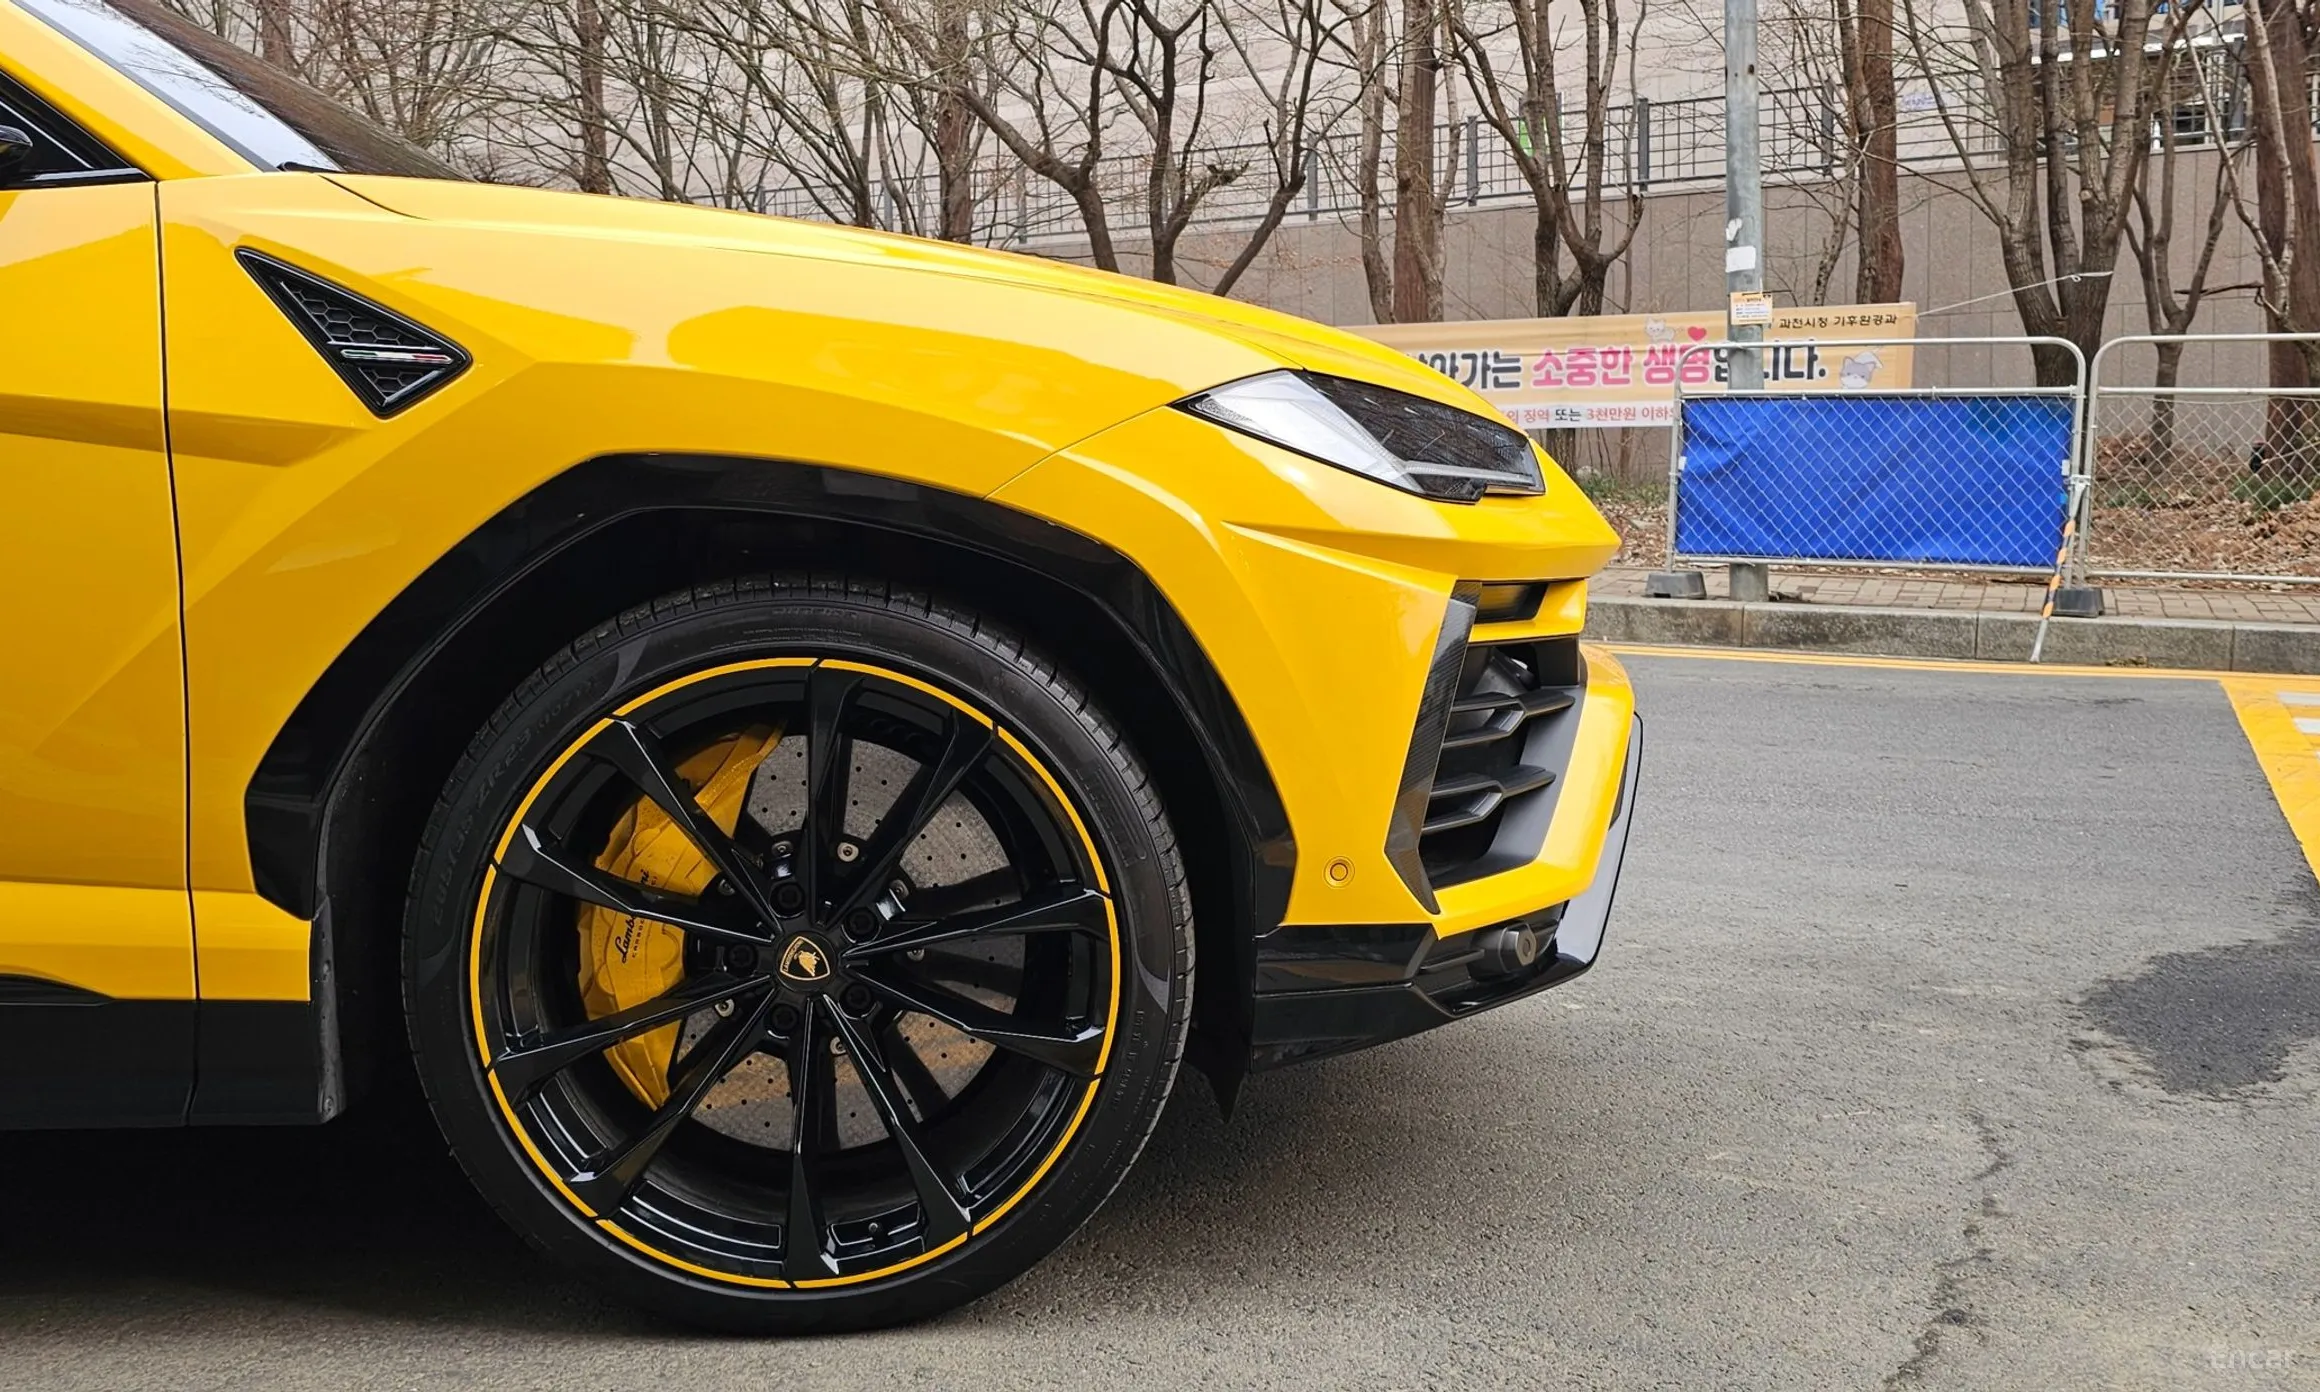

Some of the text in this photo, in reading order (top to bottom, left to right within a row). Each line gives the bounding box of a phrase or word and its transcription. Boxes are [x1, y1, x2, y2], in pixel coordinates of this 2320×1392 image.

[1418, 350, 1521, 389] 아가는
[1532, 345, 1632, 387] 소중한
[1524, 408, 1550, 423] 징역
[1555, 408, 1582, 422] 또는
[1586, 406, 1636, 422] 3천만원
